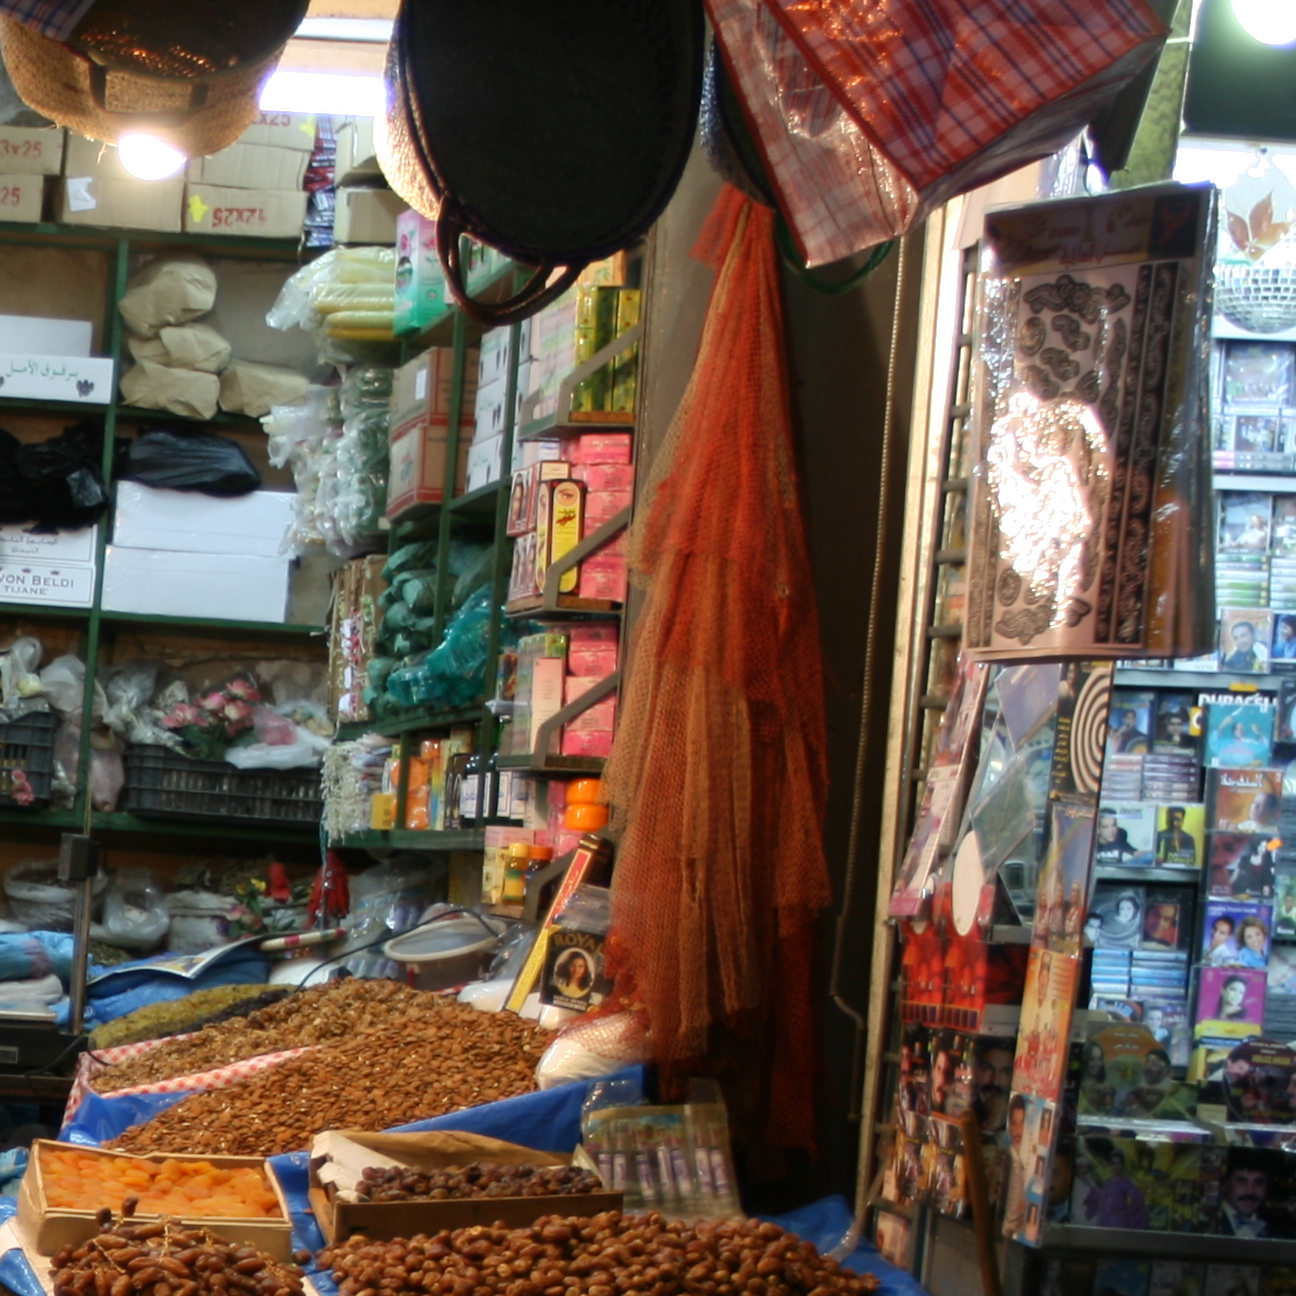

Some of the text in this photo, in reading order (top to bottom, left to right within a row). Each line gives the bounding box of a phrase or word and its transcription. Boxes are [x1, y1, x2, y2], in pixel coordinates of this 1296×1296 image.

[32, 575, 75, 588] BELDI
[4, 585, 48, 596] TIJANE
[553, 933, 604, 953] ROYAL
